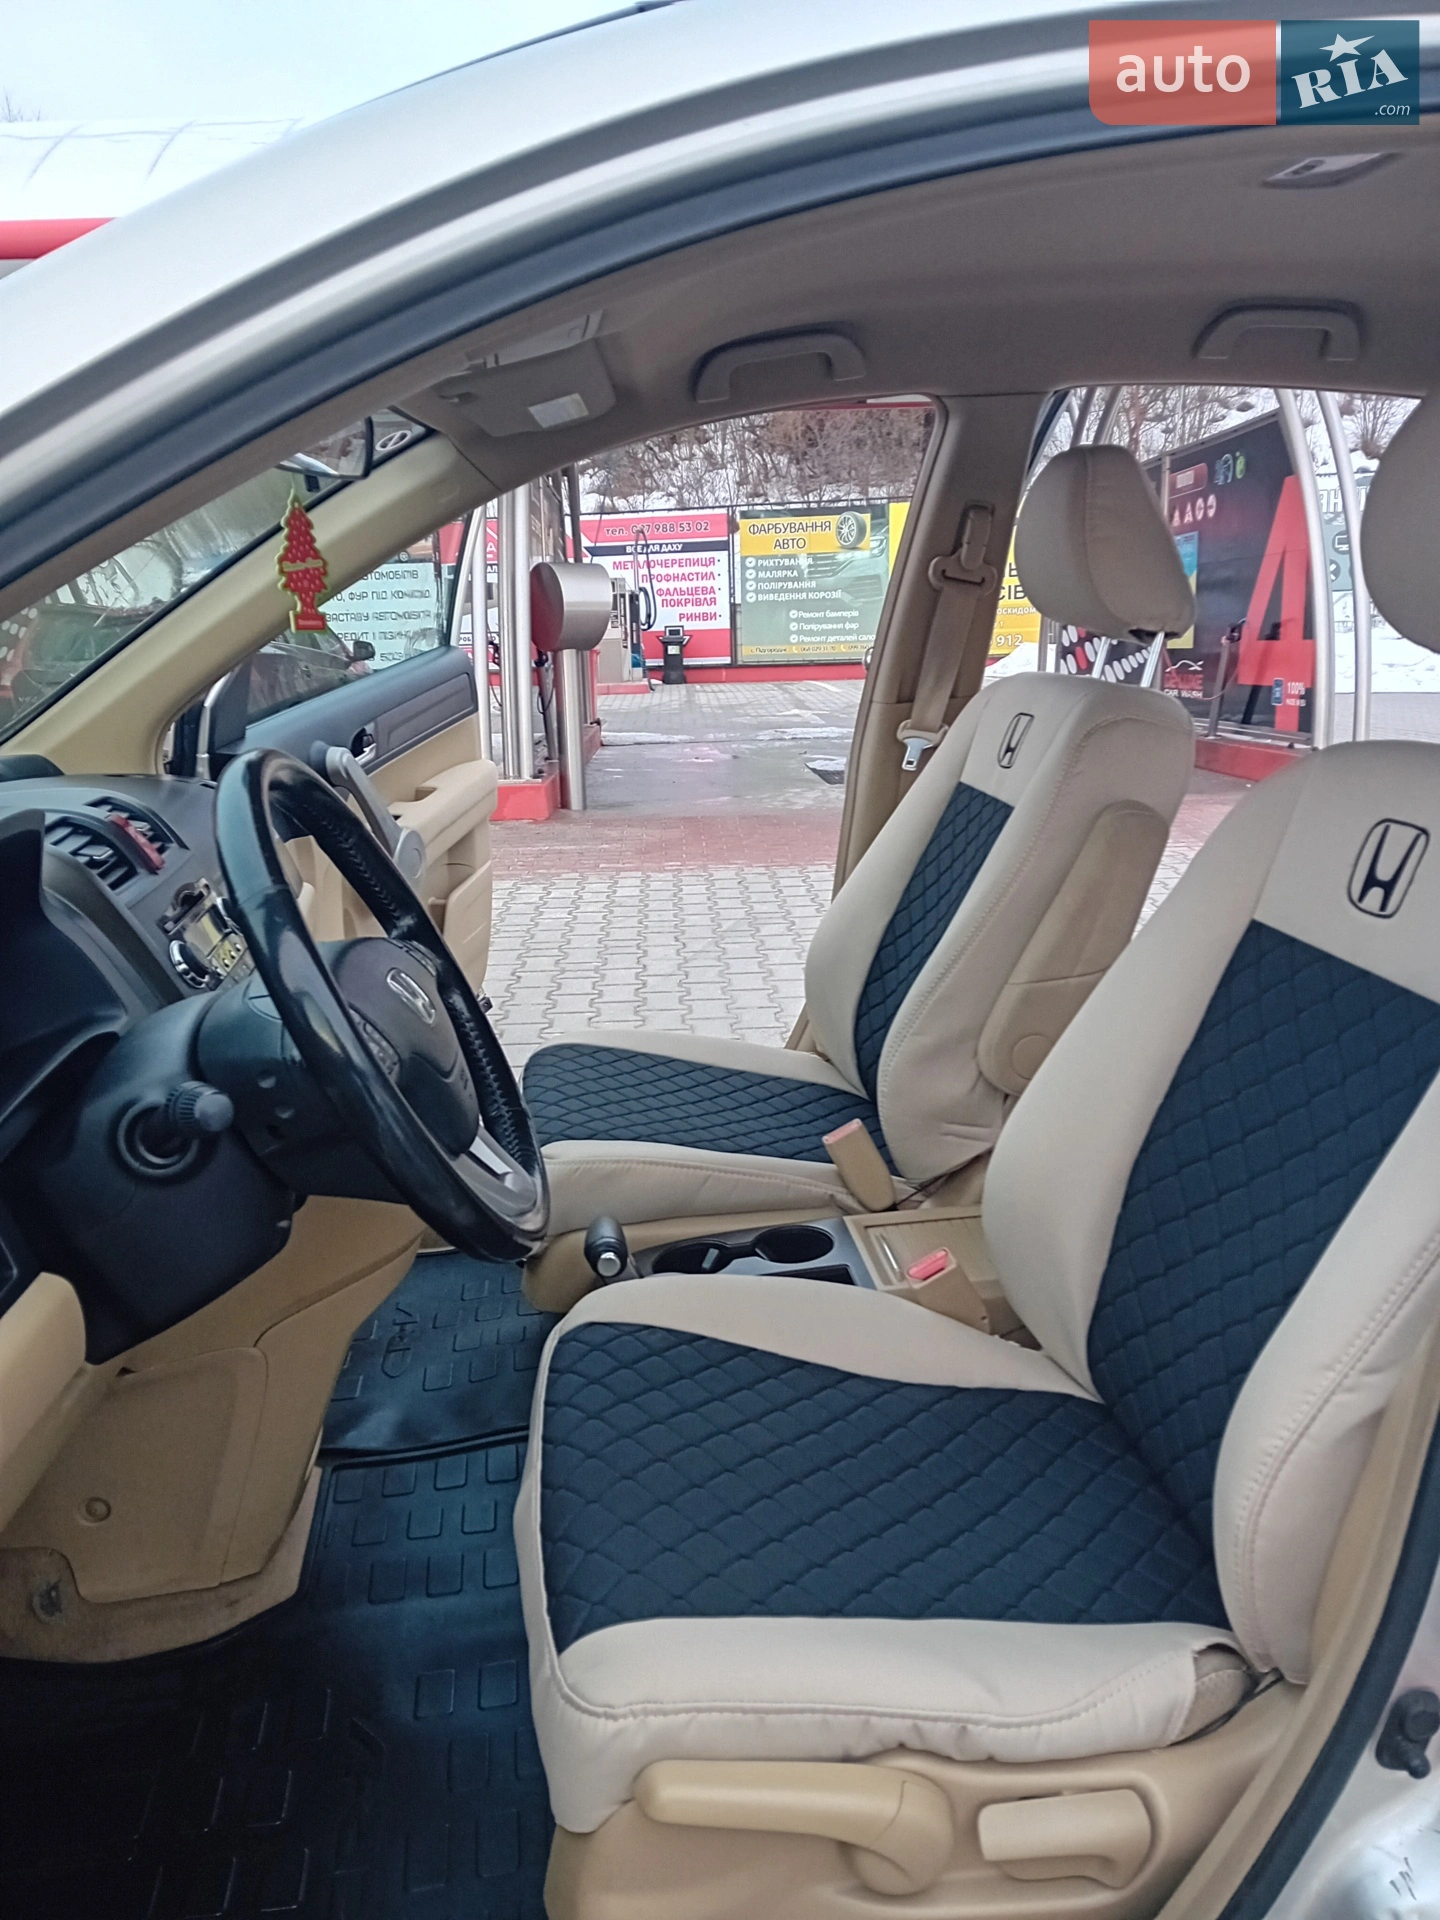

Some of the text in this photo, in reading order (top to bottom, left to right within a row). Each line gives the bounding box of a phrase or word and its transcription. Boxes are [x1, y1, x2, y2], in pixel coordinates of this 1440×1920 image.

[605, 527, 628, 536] тел.
[654, 522, 675, 534] 988
[679, 522, 692, 532] 53
[695, 521, 710, 531] 02
[748, 520, 832, 536] ФАРБУВАННЯ
[661, 543, 683, 552] ДАХУ
[773, 538, 807, 550] АВТО
[758, 557, 813, 567] РИХТУВАННЯ
[641, 571, 716, 584] ПРОФНАСТИЛ
[758, 570, 799, 579] МАЛЯРКА
[758, 581, 817, 591] ПОЛІРУВАННЯ
[656, 586, 716, 597] ФАЛЬЦЕВА
[758, 589, 843, 602] ВИВЕДЕННЯ КОРОЗІЇ
[661, 597, 717, 608] ПОКРІВЛЯ
[678, 612, 717, 622] РИНВИ
[798, 610, 825, 619] Ремонт
[845, 622, 859, 631] фар
[799, 635, 826, 643] Ремонт
